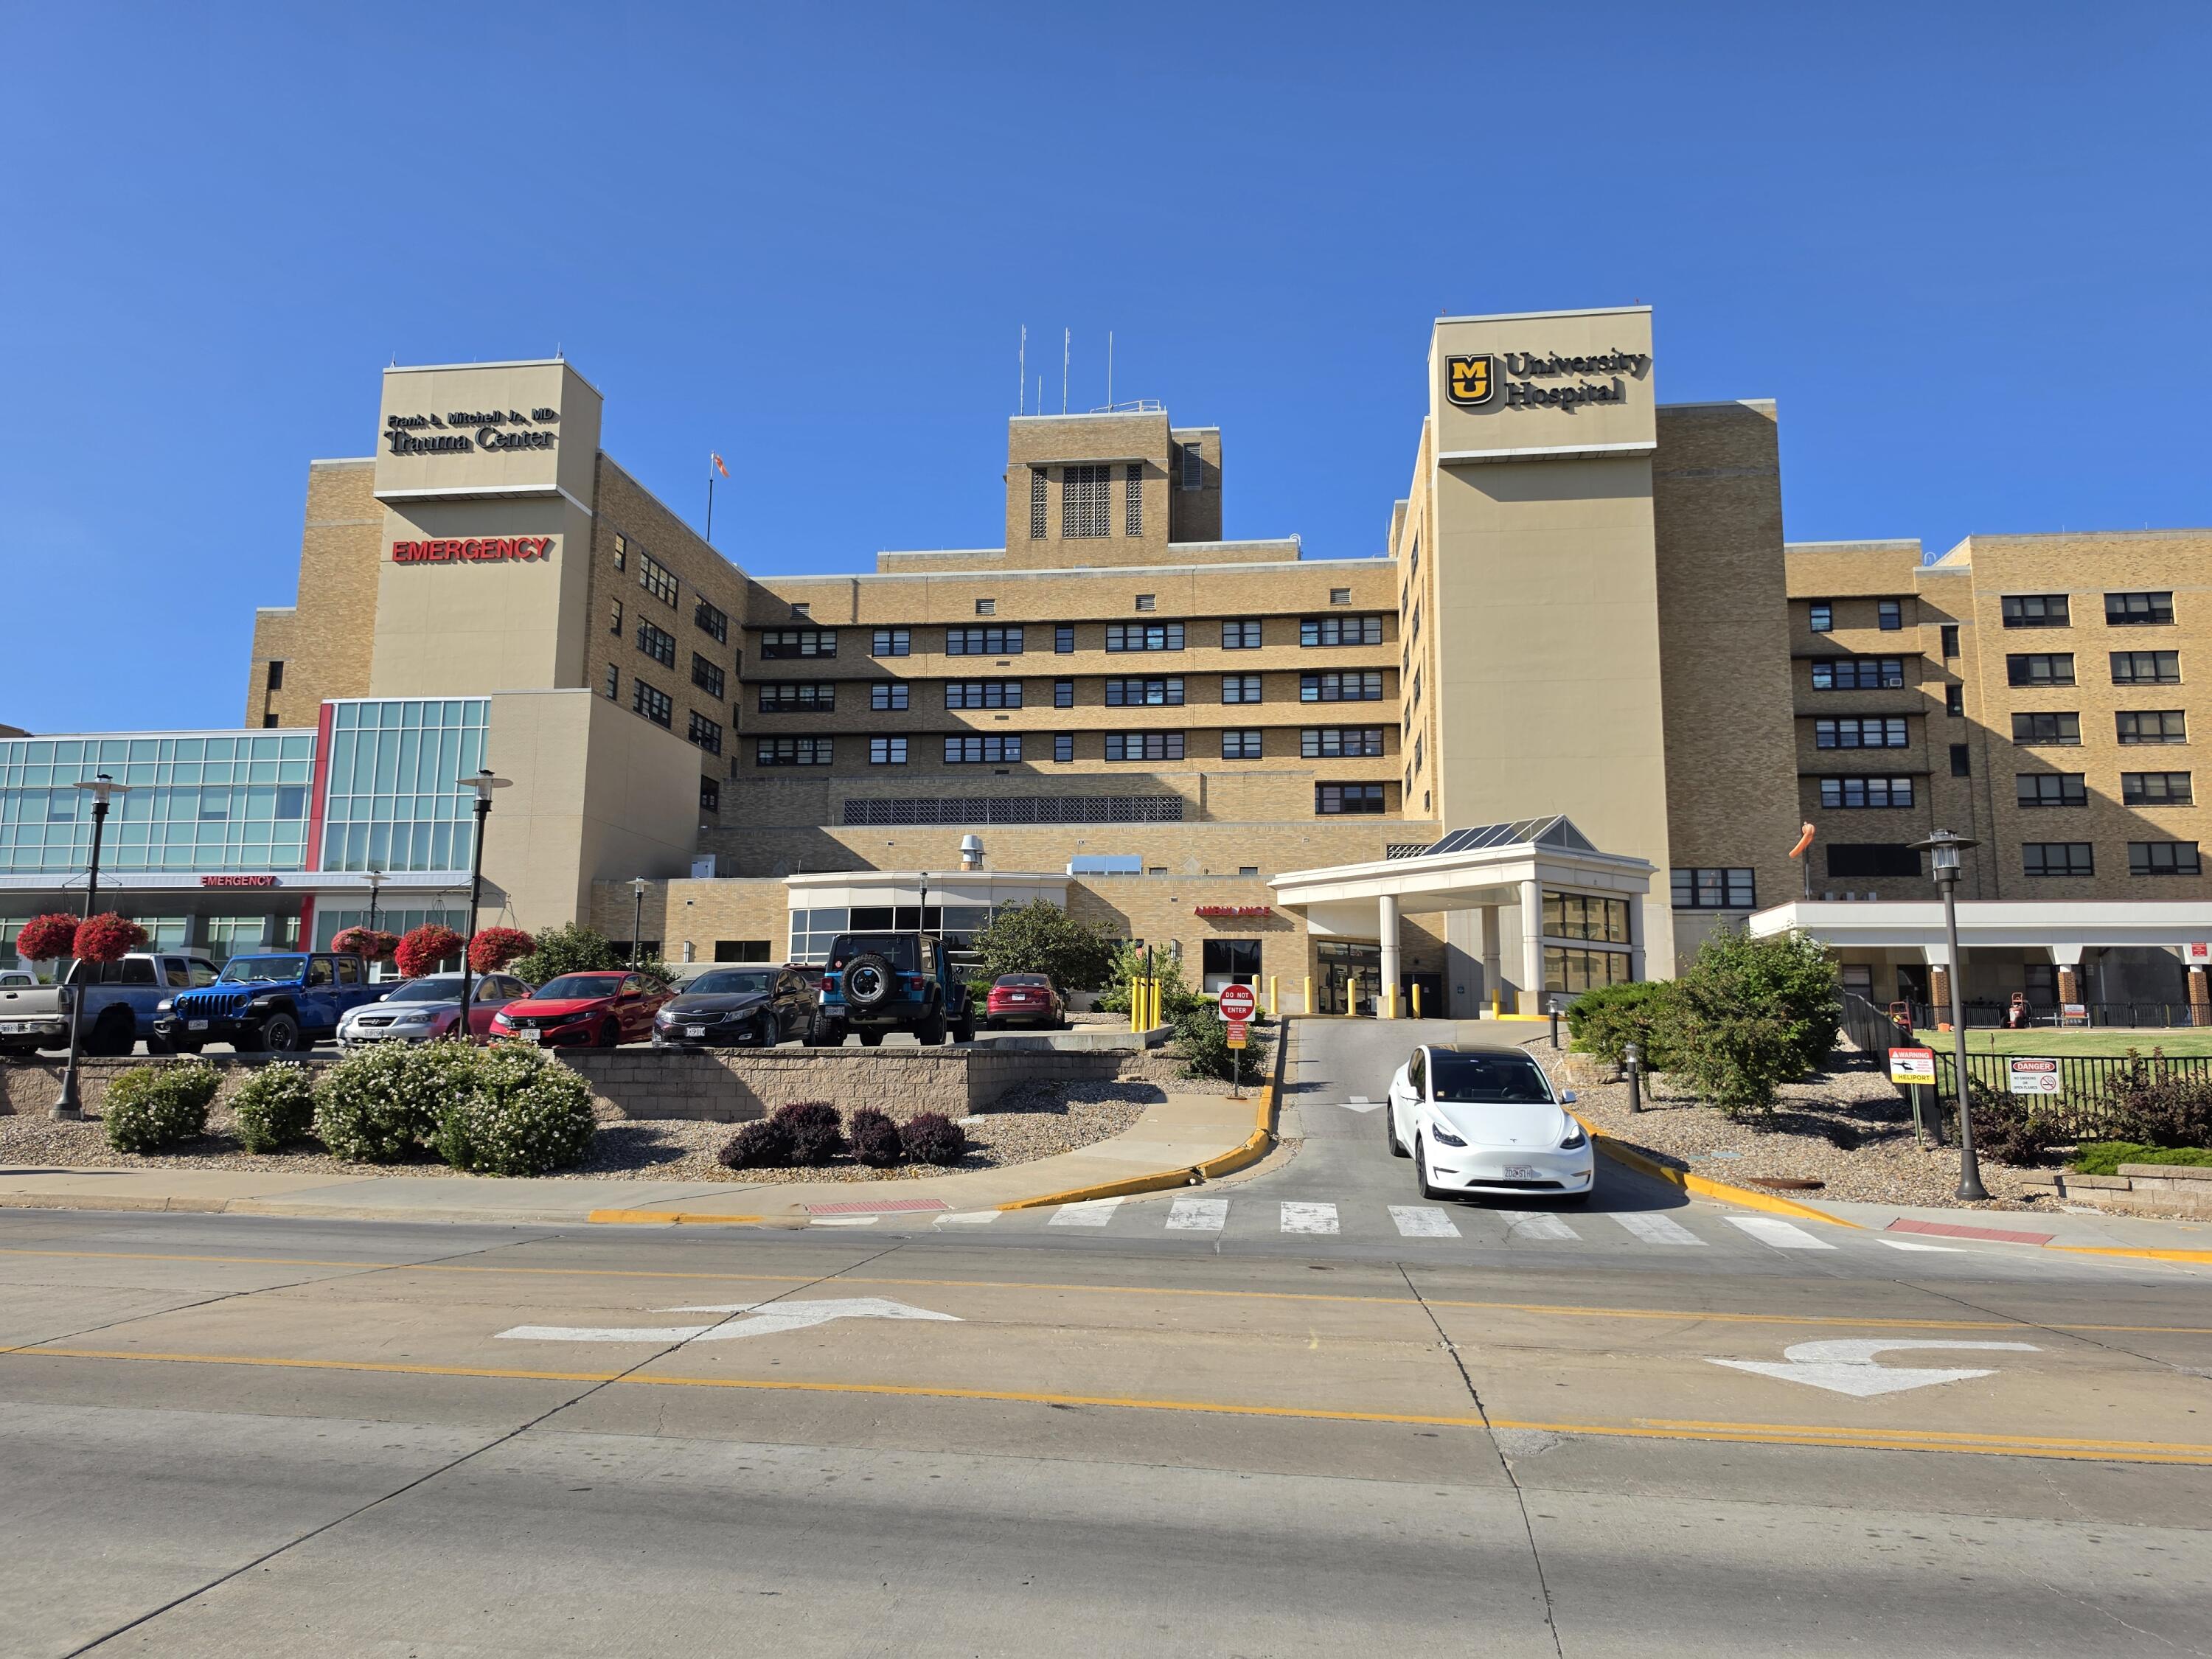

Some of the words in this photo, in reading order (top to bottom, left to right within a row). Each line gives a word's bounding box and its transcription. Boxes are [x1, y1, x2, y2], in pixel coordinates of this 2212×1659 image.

[1503, 347, 1646, 377] University
[1503, 376, 1619, 410] Hospital
[387, 414, 425, 427] Frank
[430, 413, 442, 425] L.
[448, 410, 500, 424] Mitchell
[531, 407, 554, 420] MD
[383, 430, 467, 453] Trauma
[475, 426, 554, 449] Center
[392, 537, 549, 562] EMERGENCY
[200, 875, 274, 886] EMERGENCY
[1194, 905, 1270, 916] AMBULANCE
[2017, 1062, 2051, 1071] DANGER
